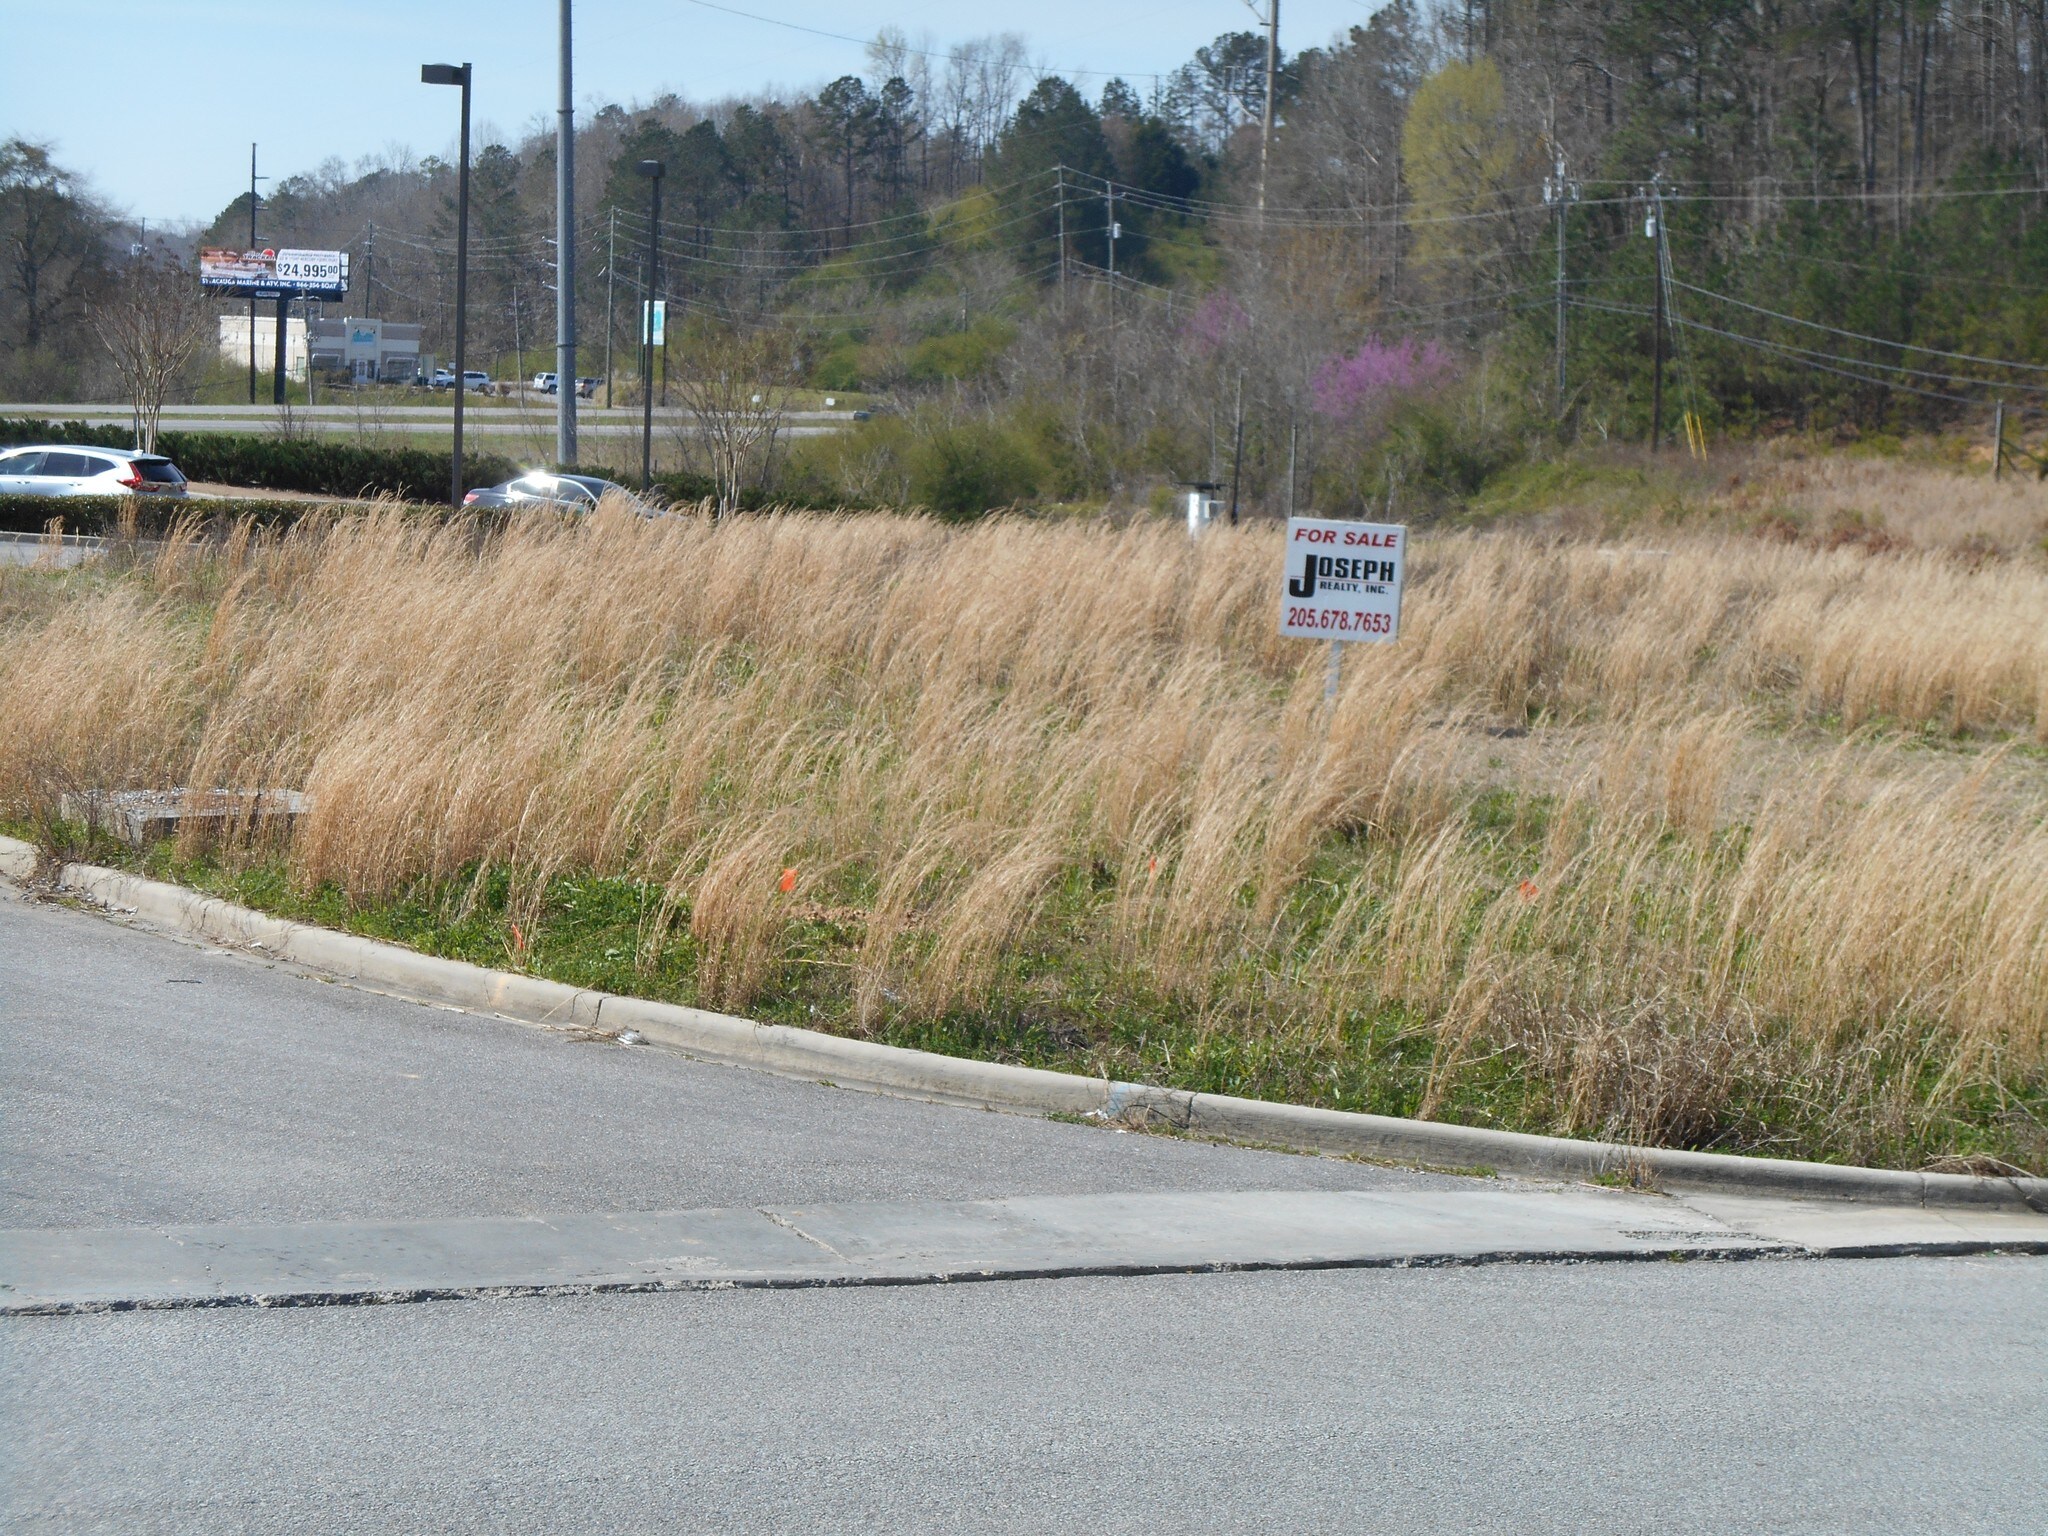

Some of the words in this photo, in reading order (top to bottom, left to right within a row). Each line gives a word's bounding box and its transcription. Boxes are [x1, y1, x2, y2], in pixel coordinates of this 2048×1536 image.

[1295, 528, 1336, 543] FOR
[1344, 532, 1397, 547] SALE
[1289, 554, 1395, 598] JOSEPH
[1319, 581, 1361, 593] REALTY,
[1366, 585, 1388, 595] INC.
[1287, 607, 1391, 634] 205.678.7653
